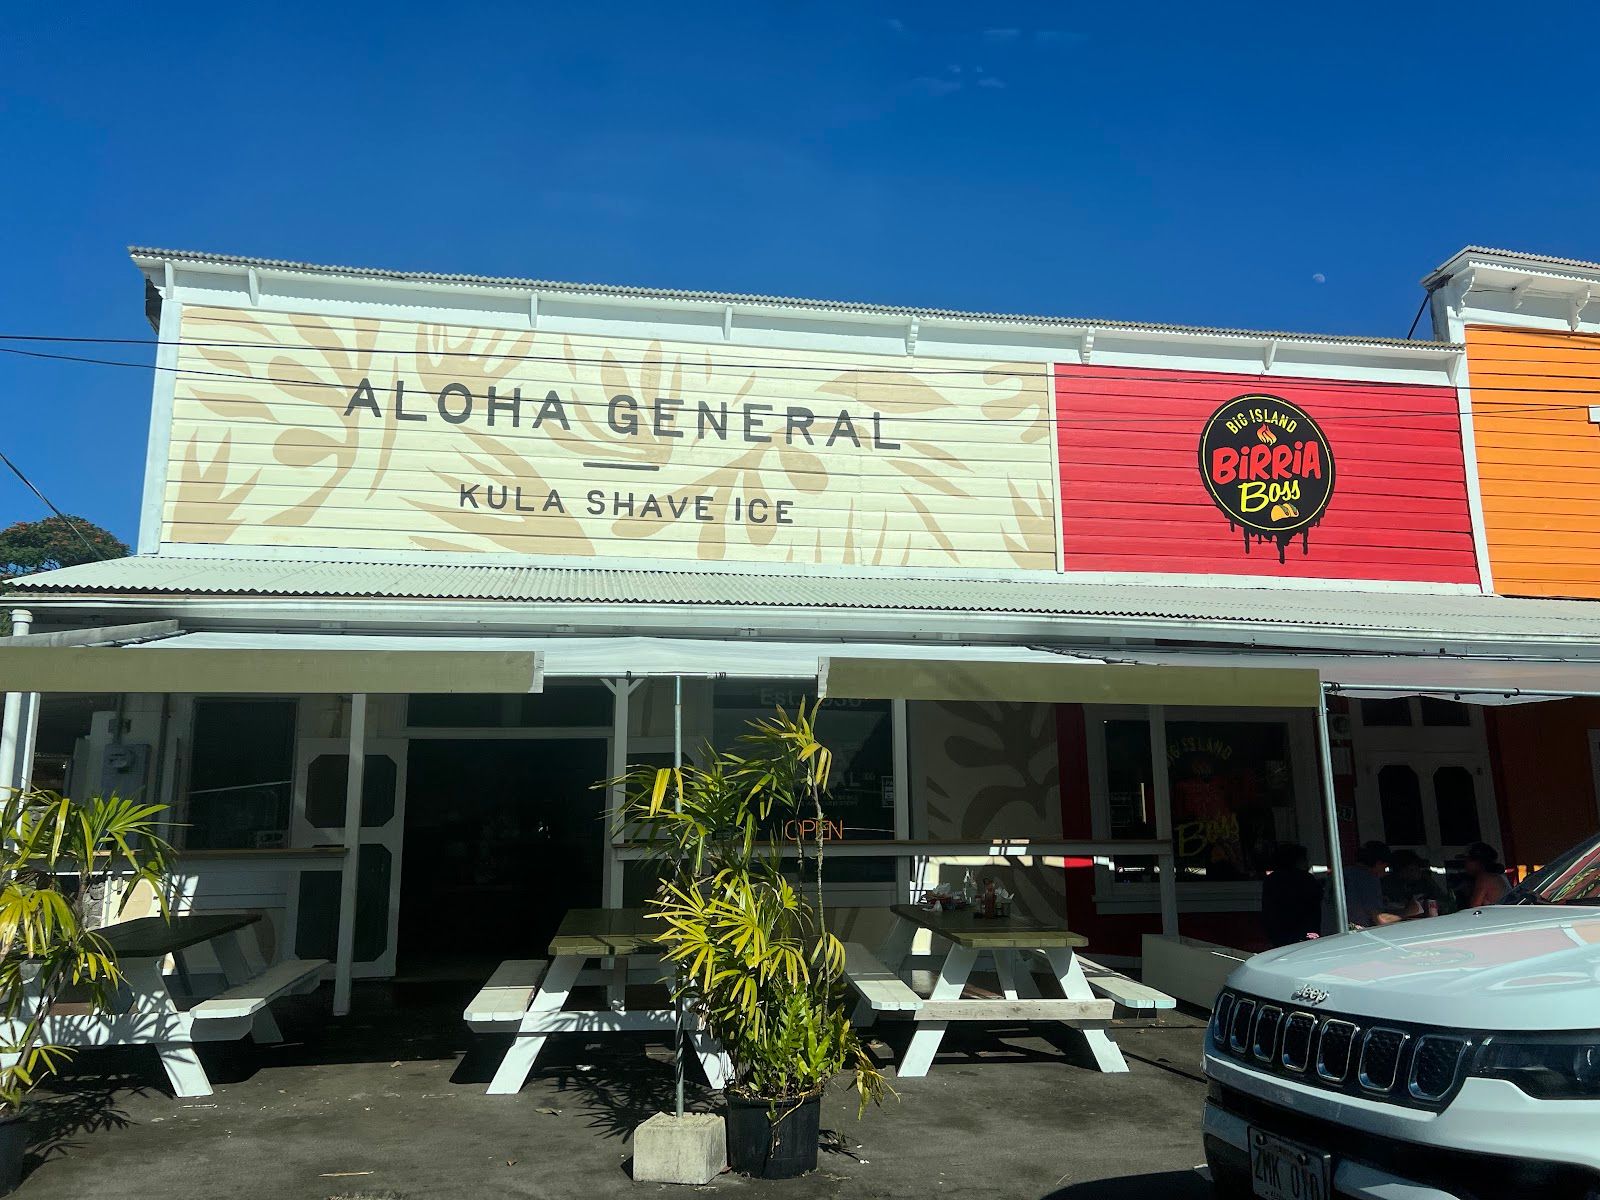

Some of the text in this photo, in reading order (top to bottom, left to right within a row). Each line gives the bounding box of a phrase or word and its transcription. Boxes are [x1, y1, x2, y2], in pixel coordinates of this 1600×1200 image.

[343, 378, 901, 451] ALOHA GENERAL
[1225, 408, 1298, 435] BIG ISLAND
[460, 483, 794, 524] KULA SHAVE ICE
[1237, 479, 1301, 513] Boss
[784, 819, 843, 841] OPEN
[1294, 984, 1330, 1004] Jeep
